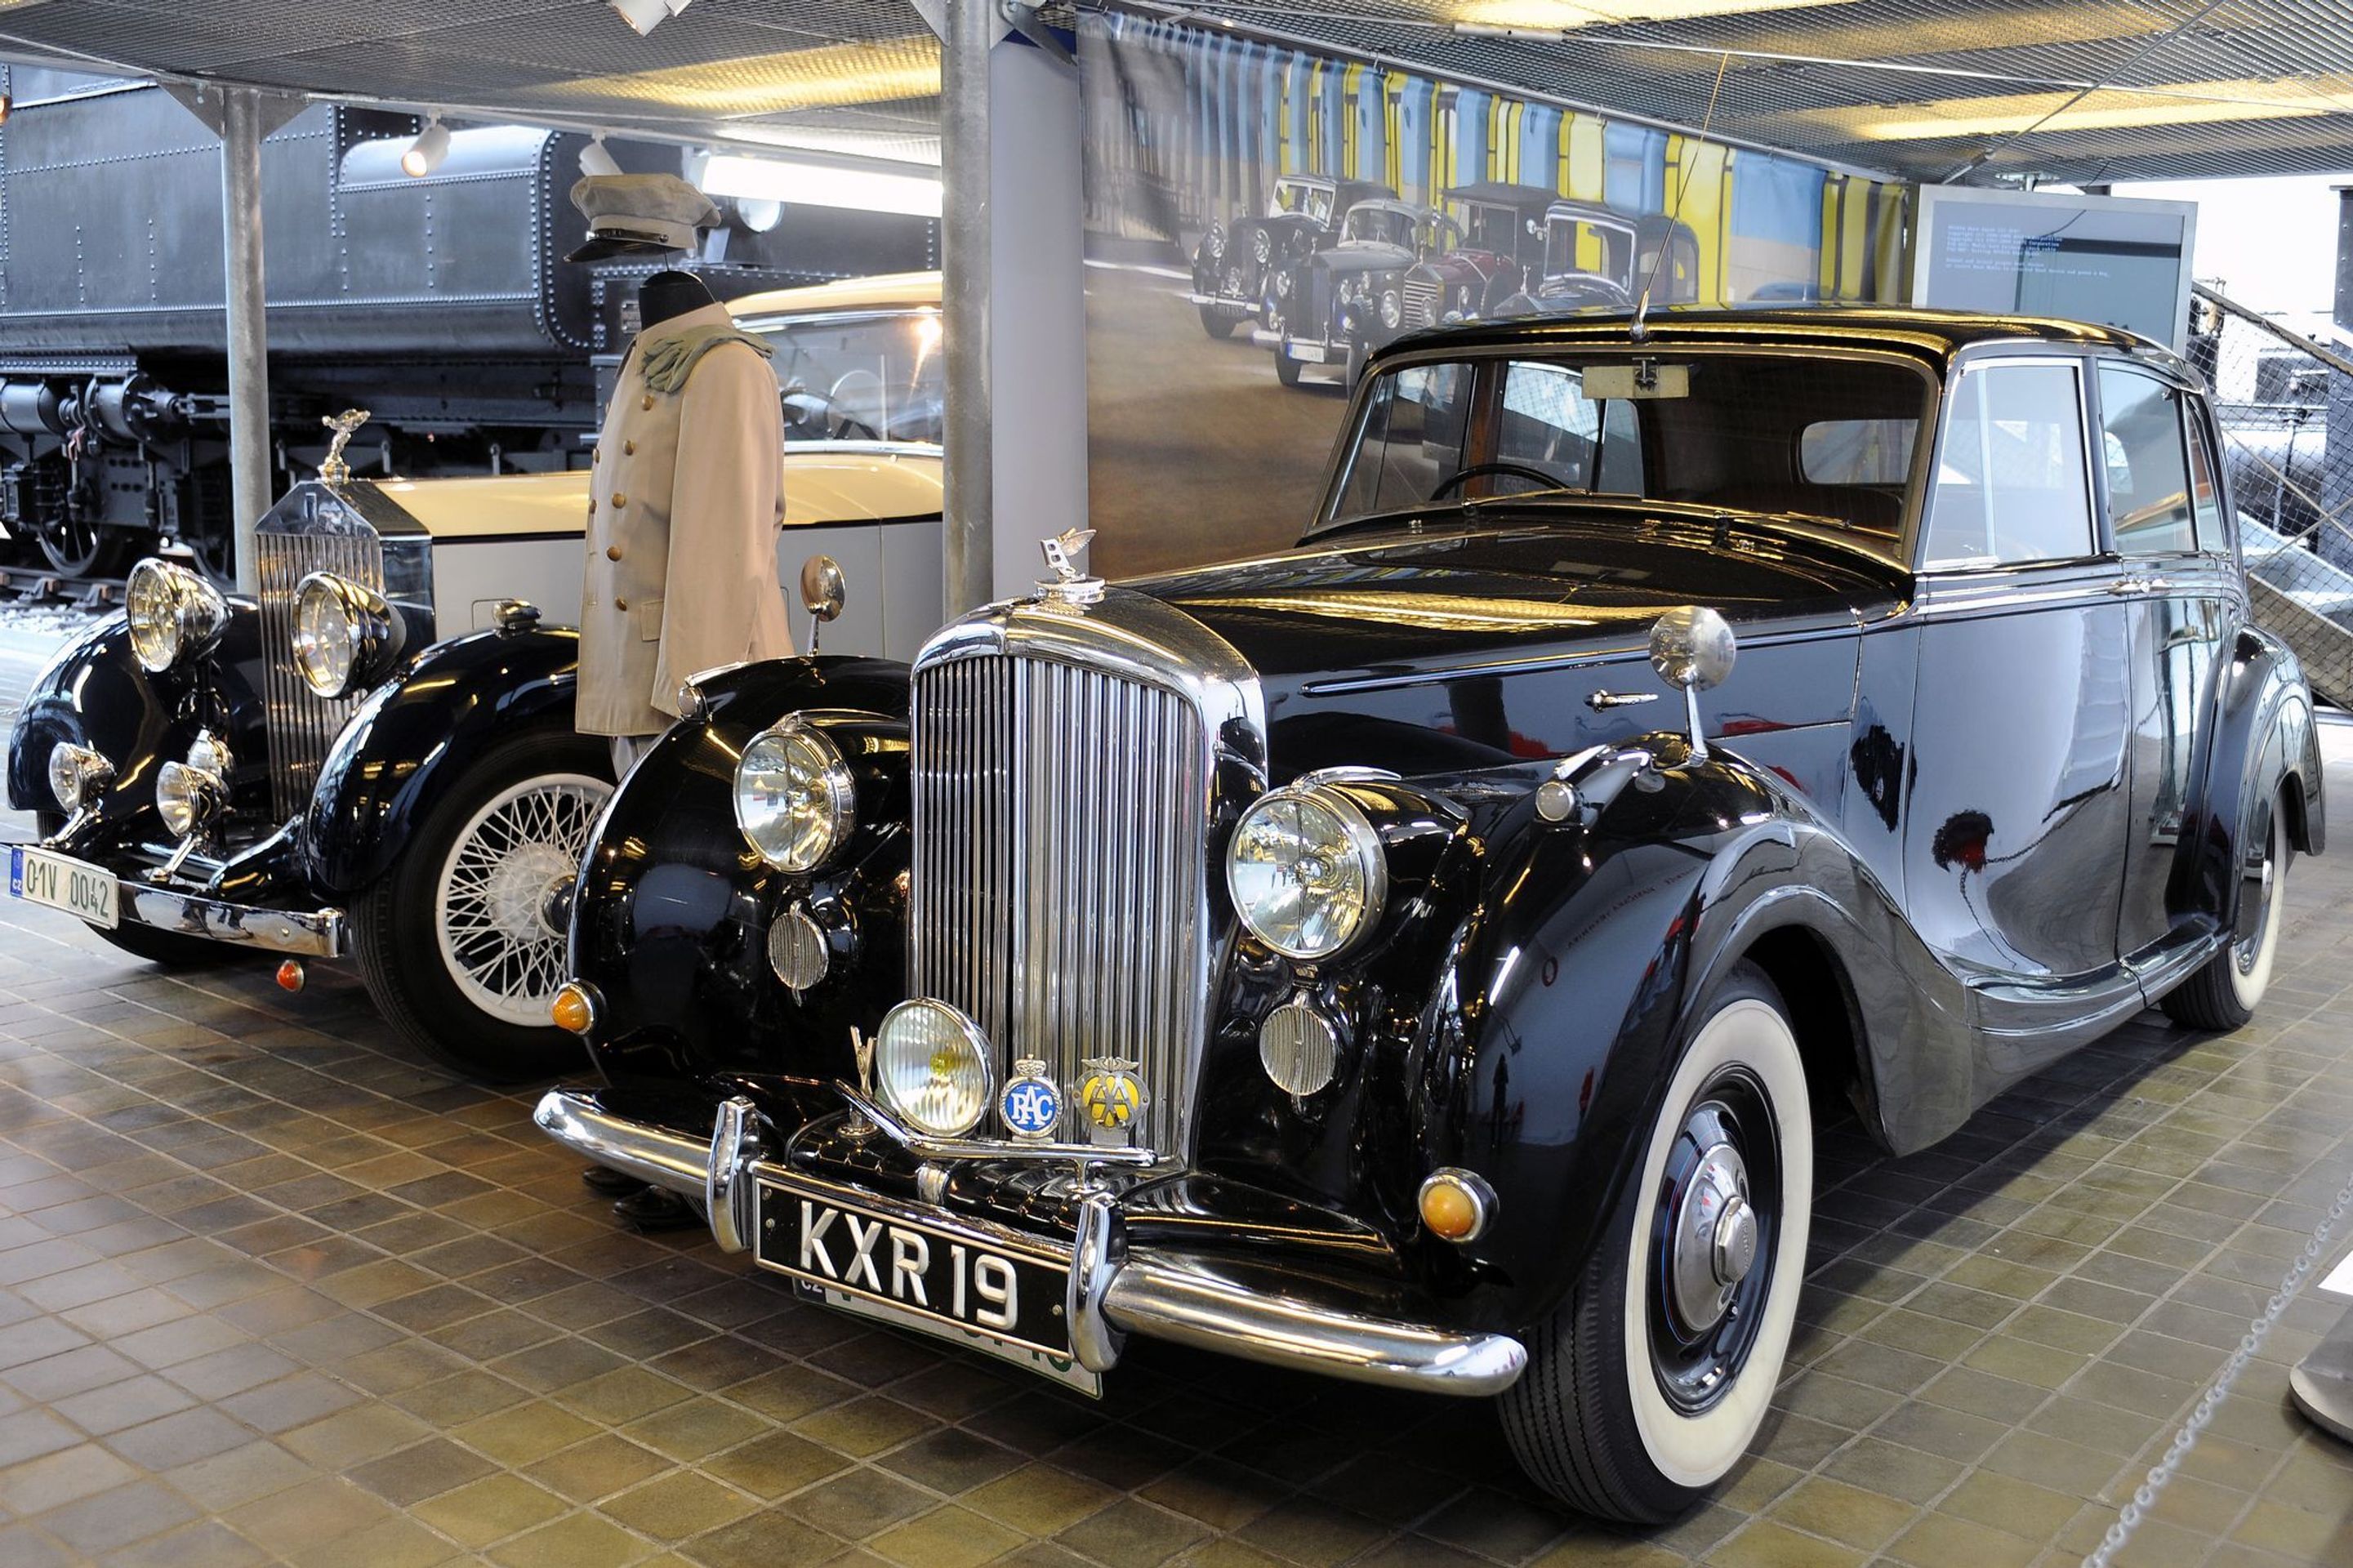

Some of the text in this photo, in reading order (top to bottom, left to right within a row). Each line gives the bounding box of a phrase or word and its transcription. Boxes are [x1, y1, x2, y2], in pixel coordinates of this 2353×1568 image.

[12, 879, 22, 891] CZ
[70, 871, 109, 918] 0042
[1011, 1085, 1053, 1125] RAC
[800, 1200, 1018, 1330] KXR 19
